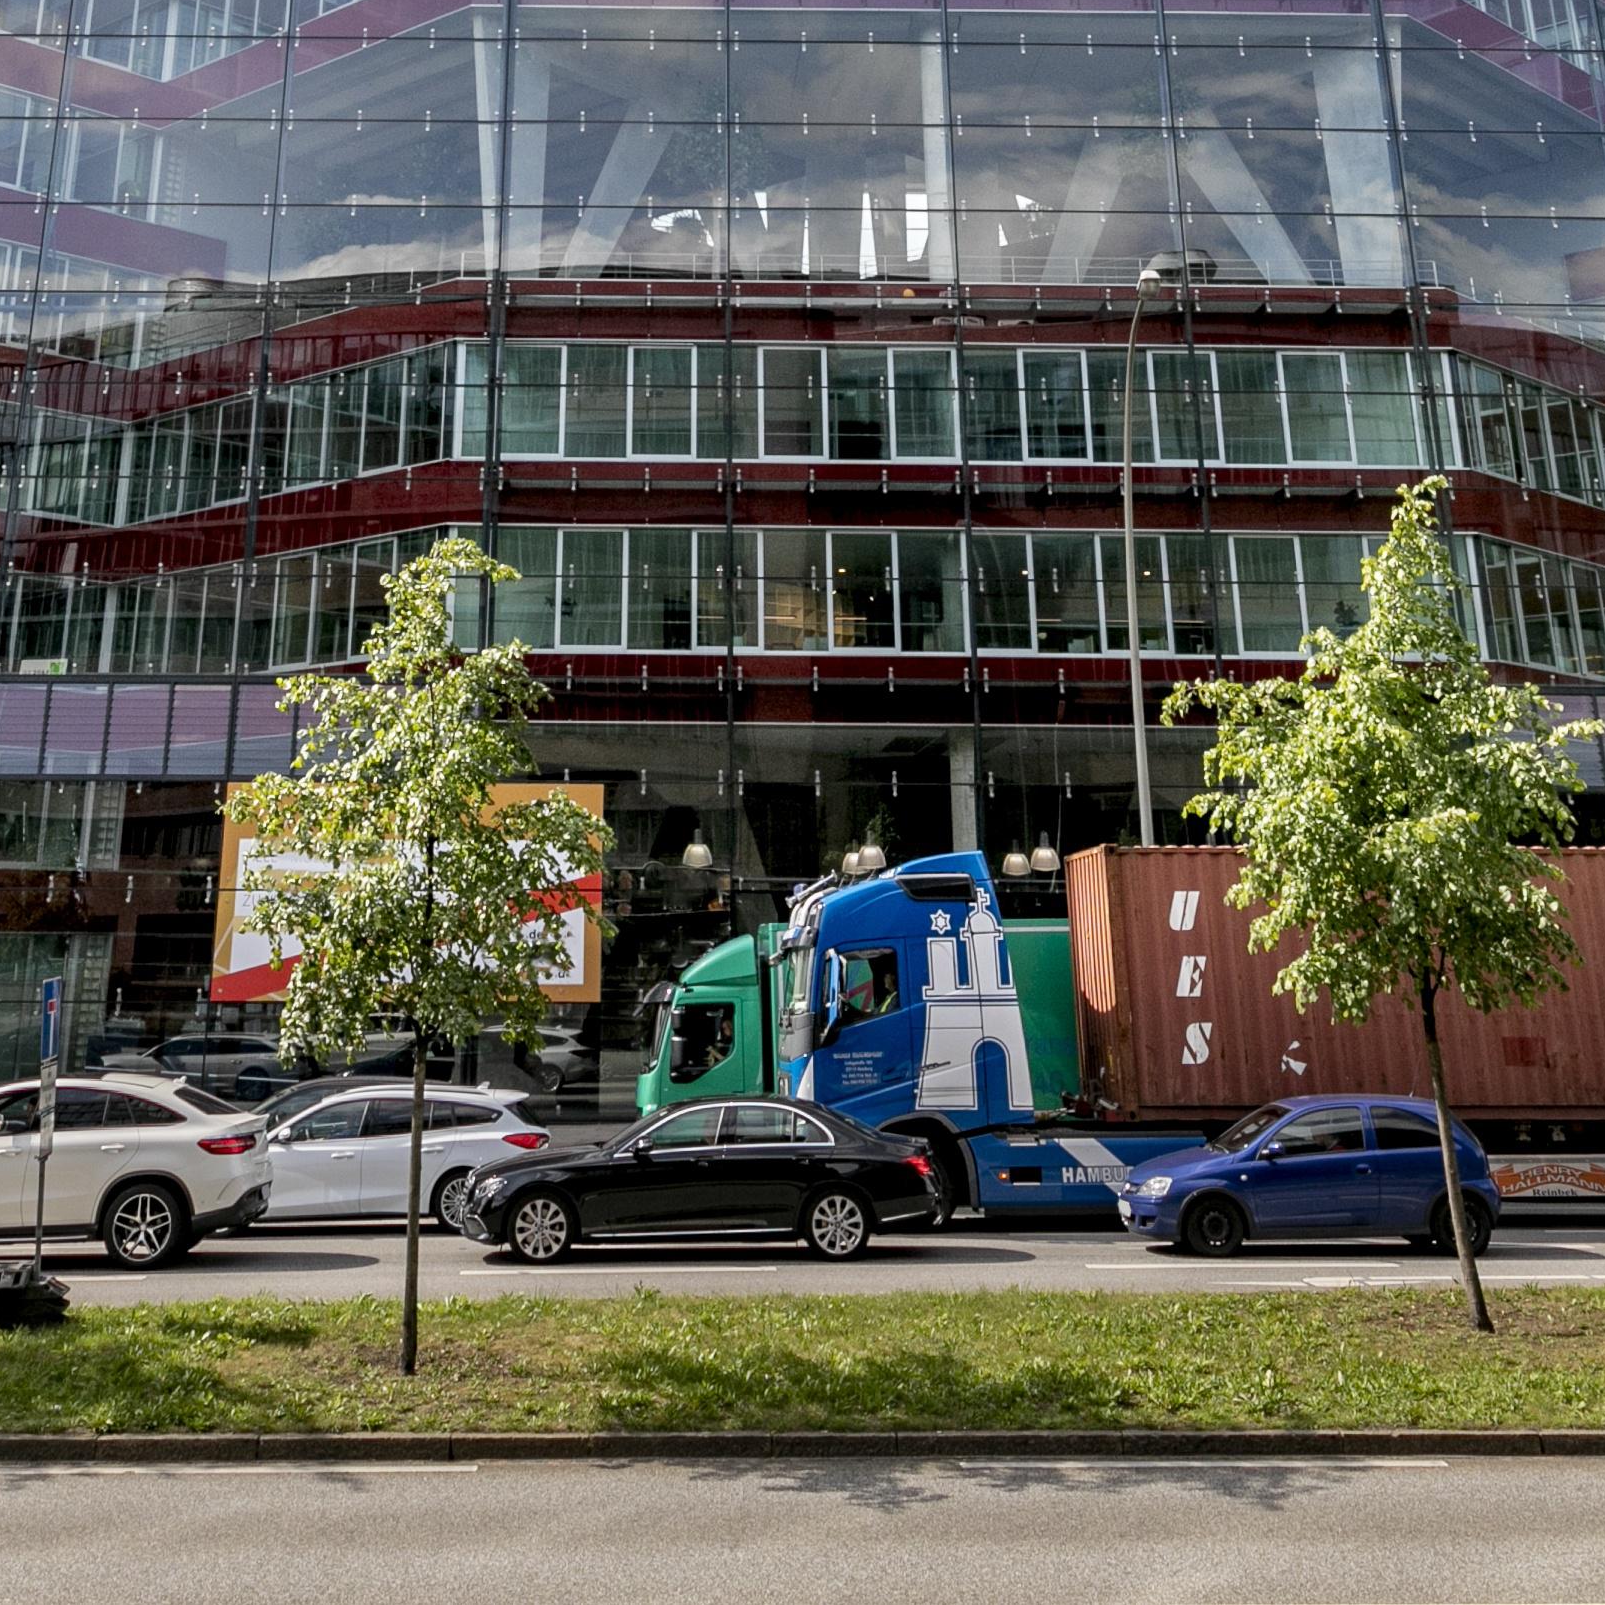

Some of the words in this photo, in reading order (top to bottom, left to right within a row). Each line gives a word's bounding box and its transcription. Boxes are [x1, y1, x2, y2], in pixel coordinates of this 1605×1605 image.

[1169, 891, 1212, 1064] UES
[1520, 1165, 1582, 1180] HENRY
[1532, 1188, 1578, 1196] Reinbek
